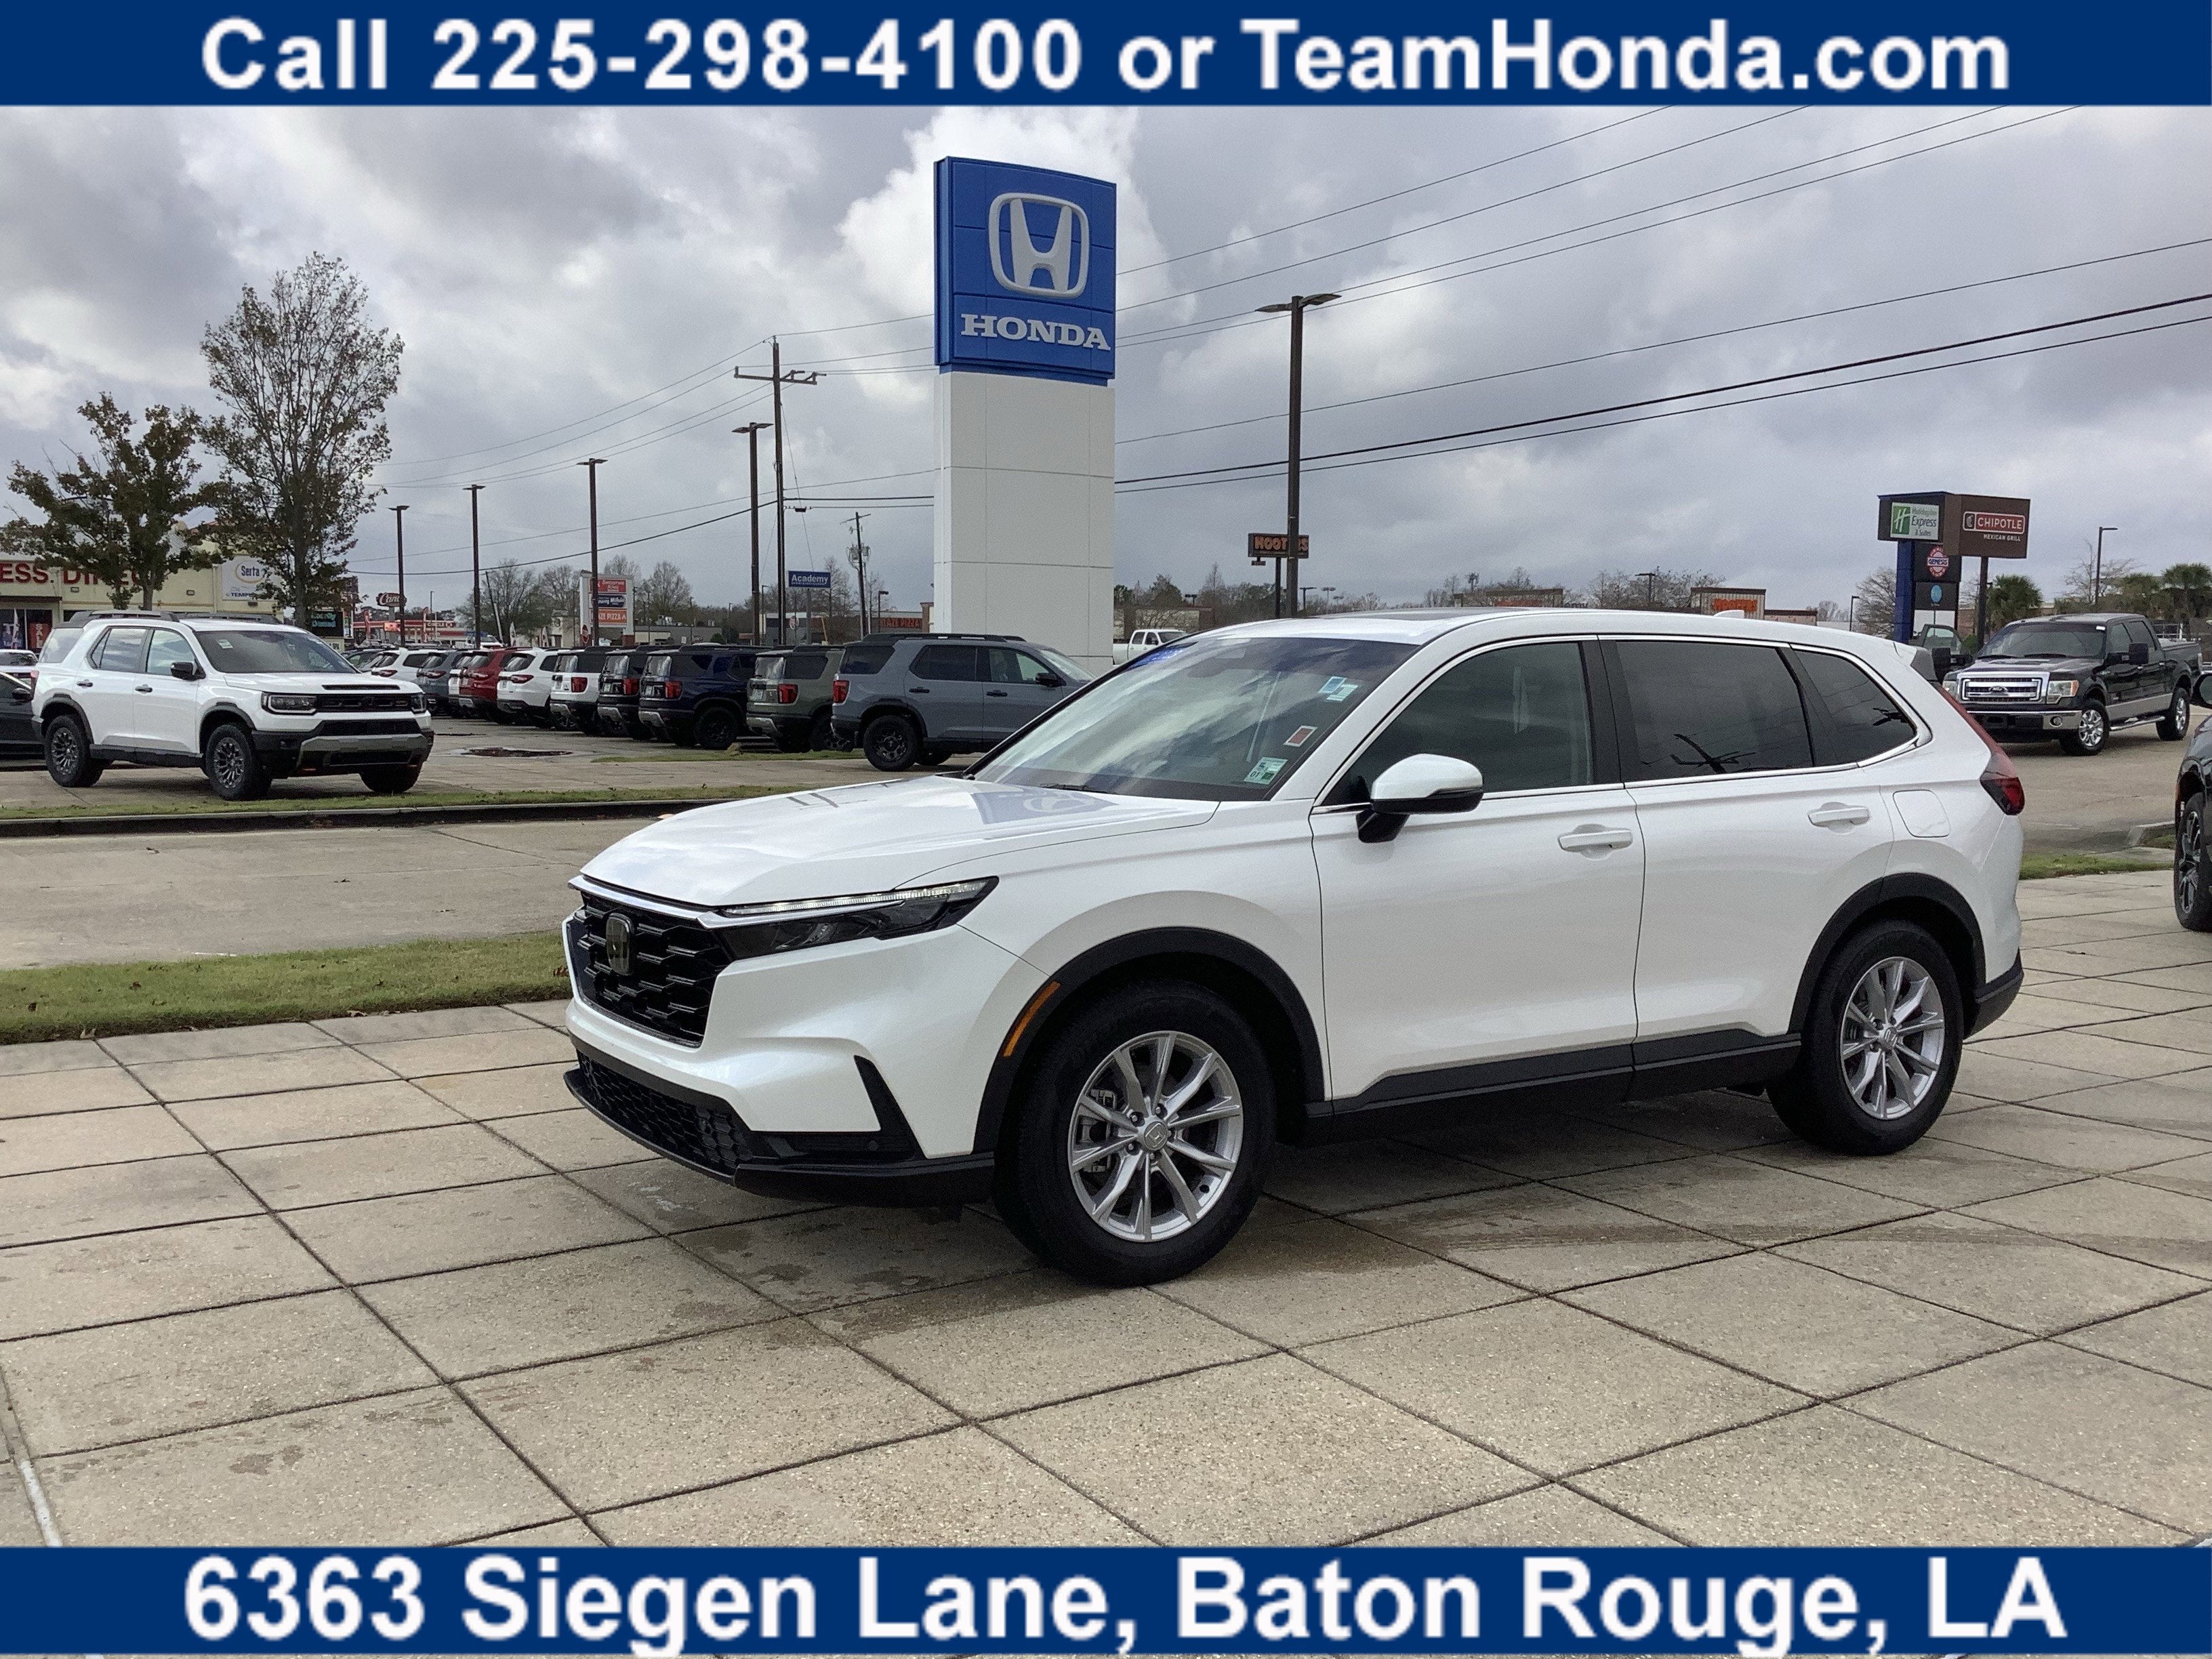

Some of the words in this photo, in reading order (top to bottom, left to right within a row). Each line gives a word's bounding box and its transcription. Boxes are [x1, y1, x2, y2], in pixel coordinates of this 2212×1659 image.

[961, 314, 1111, 350] HONDA
[1911, 516, 1936, 529] Express
[1978, 518, 2022, 529] CHIPOTLE
[1254, 536, 1308, 551] HOOTS
[241, 565, 260, 576] Serta
[791, 574, 828, 585] Academy
